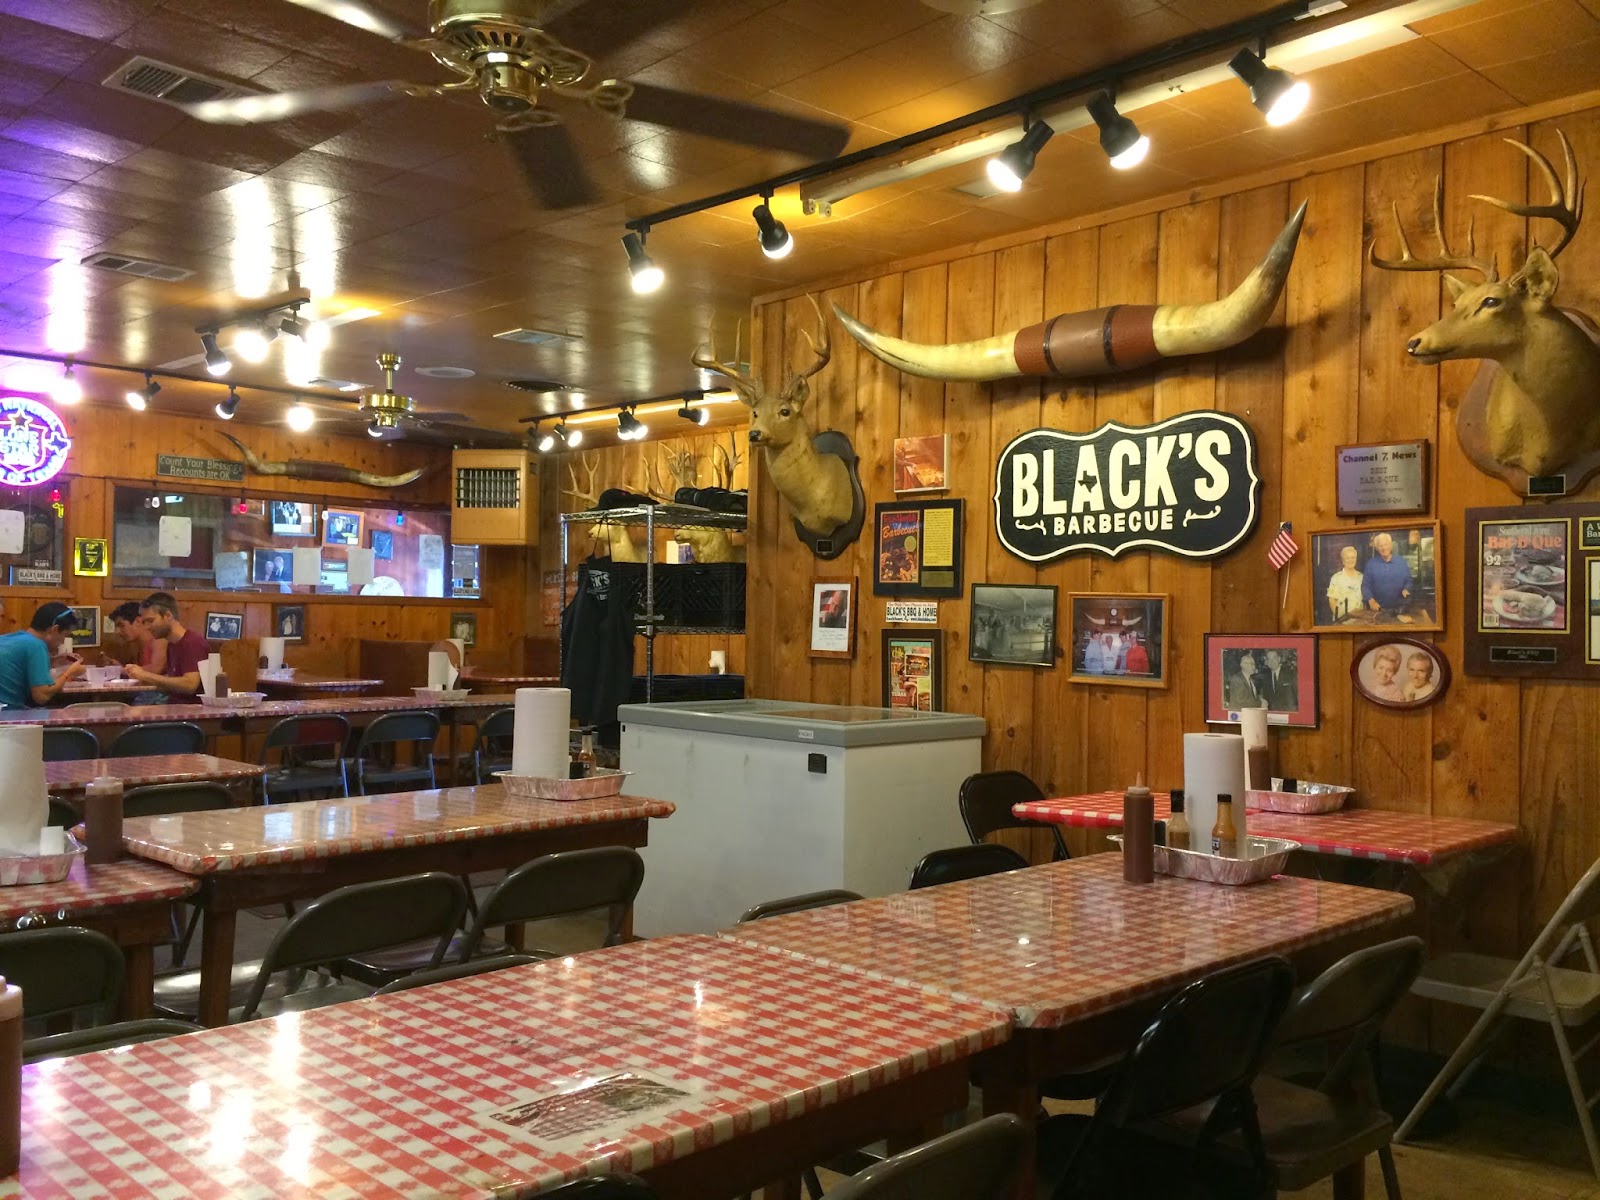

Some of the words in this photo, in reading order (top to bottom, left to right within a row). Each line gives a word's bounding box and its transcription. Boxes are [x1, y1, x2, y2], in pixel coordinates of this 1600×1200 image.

[1343, 453, 1378, 463] Channel
[1392, 451, 1417, 460] News
[160, 455, 183, 467] Count
[186, 458, 204, 468] Your
[207, 460, 243, 475] Blessings
[170, 465, 206, 478] Recounts
[219, 470, 231, 480] OK
[1012, 429, 1231, 518] BLACK'S
[1053, 508, 1174, 536] BARBECUE
[1586, 523, 1594, 531] A
[1486, 555, 1501, 566] 92
[886, 606, 906, 617] BLACK'S
[907, 607, 917, 617] BBQ
[922, 607, 937, 617] HOME
